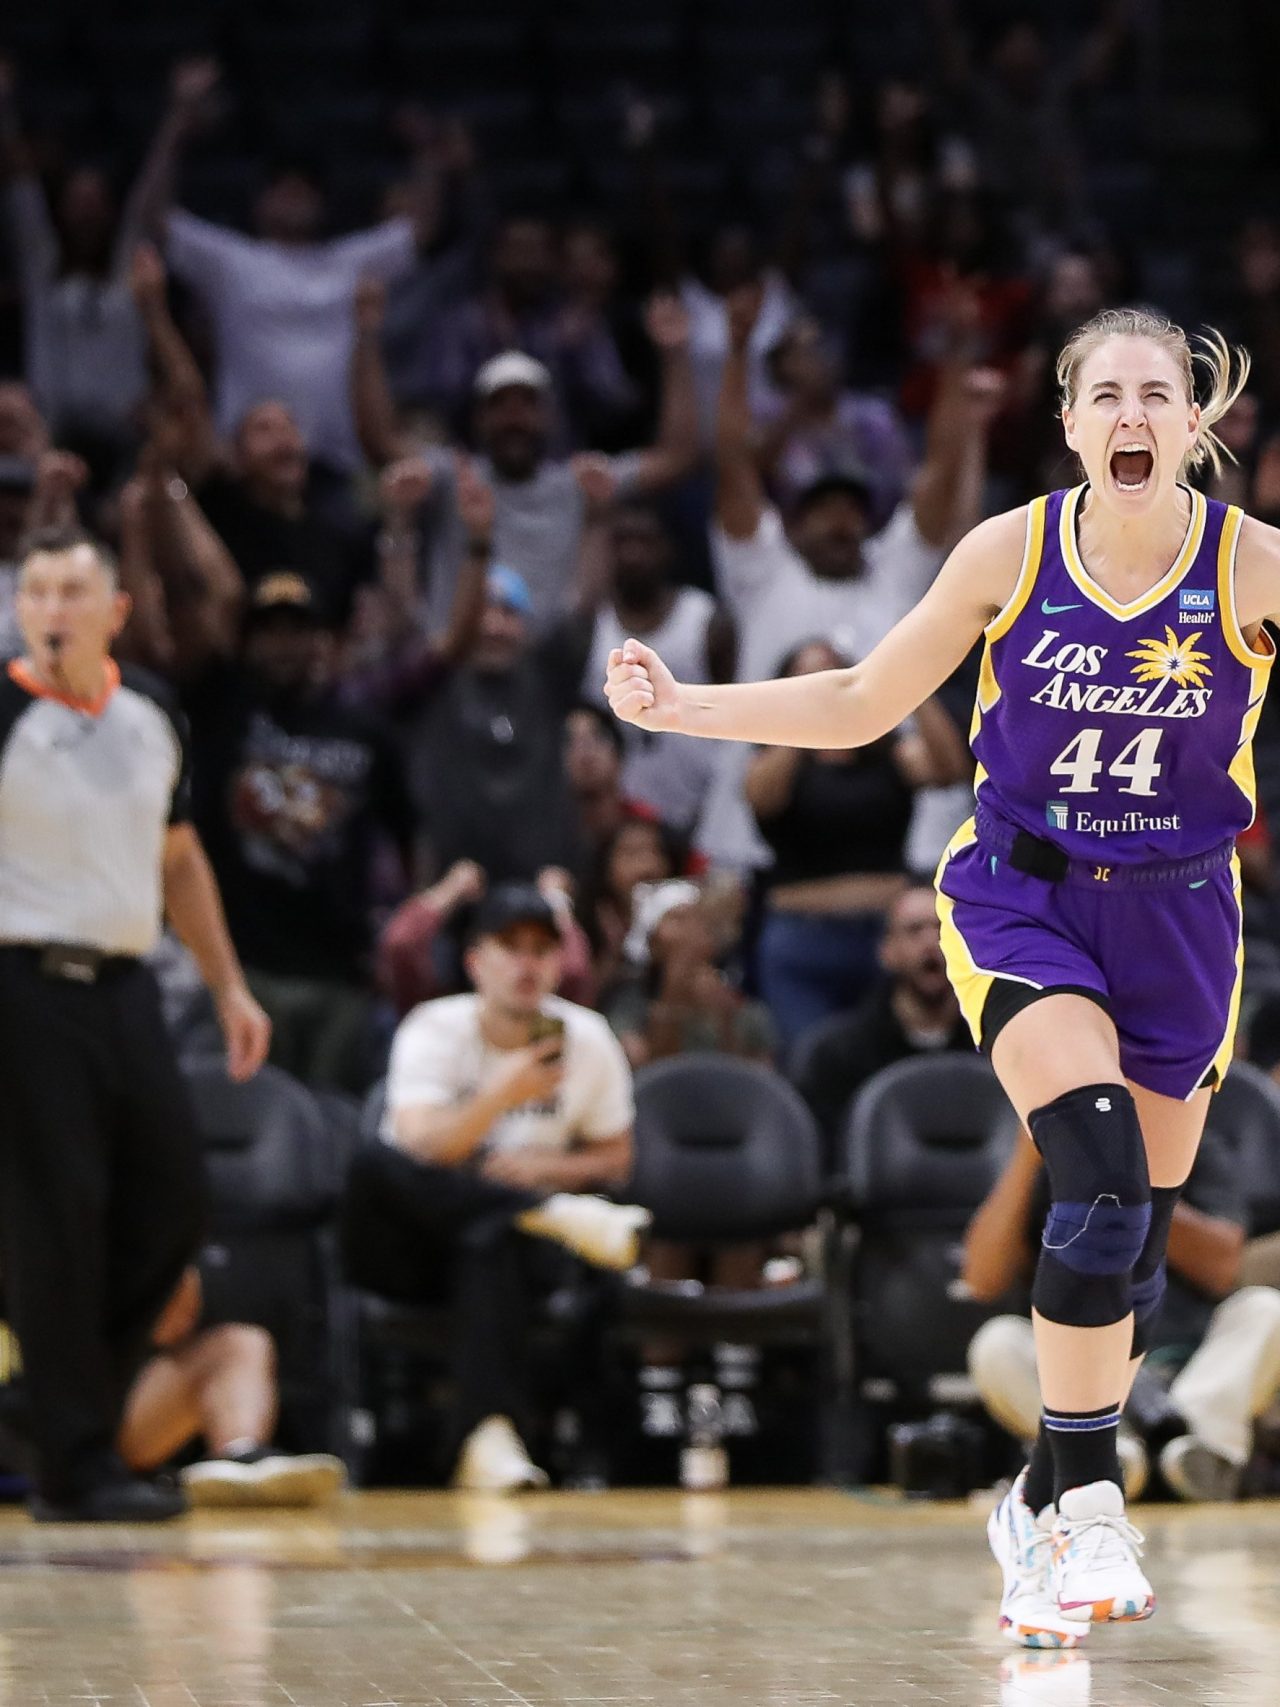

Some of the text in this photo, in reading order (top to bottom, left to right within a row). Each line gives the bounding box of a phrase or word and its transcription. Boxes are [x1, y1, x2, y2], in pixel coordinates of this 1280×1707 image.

[1183, 595, 1210, 605] UCLA
[1179, 612, 1212, 624] Health
[1050, 728, 1163, 796] 44
[1076, 811, 1181, 837] EquiTrust
